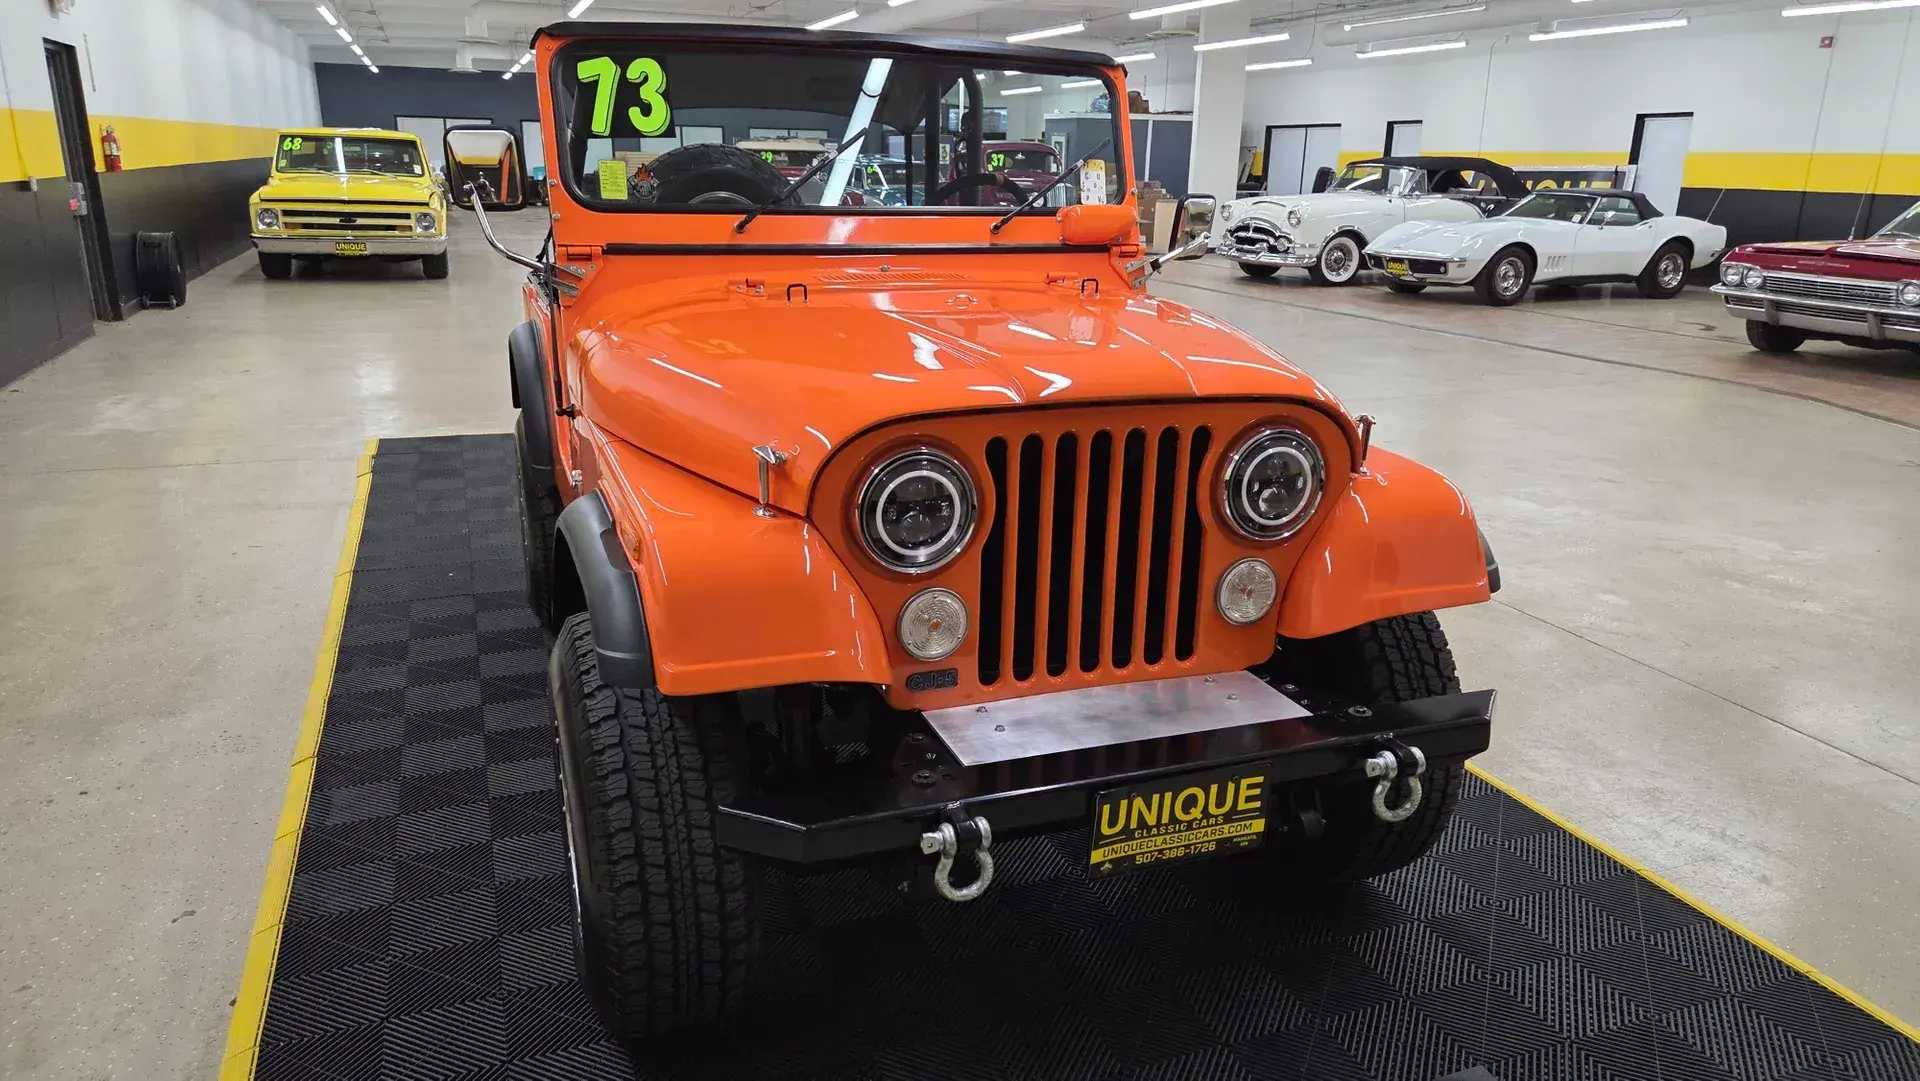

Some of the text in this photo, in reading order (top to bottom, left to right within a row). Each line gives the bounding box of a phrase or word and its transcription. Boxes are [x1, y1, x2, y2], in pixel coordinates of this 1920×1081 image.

[577, 56, 671, 137] 73
[282, 137, 303, 151] 68
[991, 153, 1005, 167] 37
[336, 242, 367, 250] UNIQUE
[1100, 776, 1264, 836] UNIQUE
[1134, 816, 1224, 838] CLASSIC CARS
[1102, 821, 1253, 859] UNIQUECLASSICCARS.COM
[1135, 841, 1216, 865] 507-386-1726
